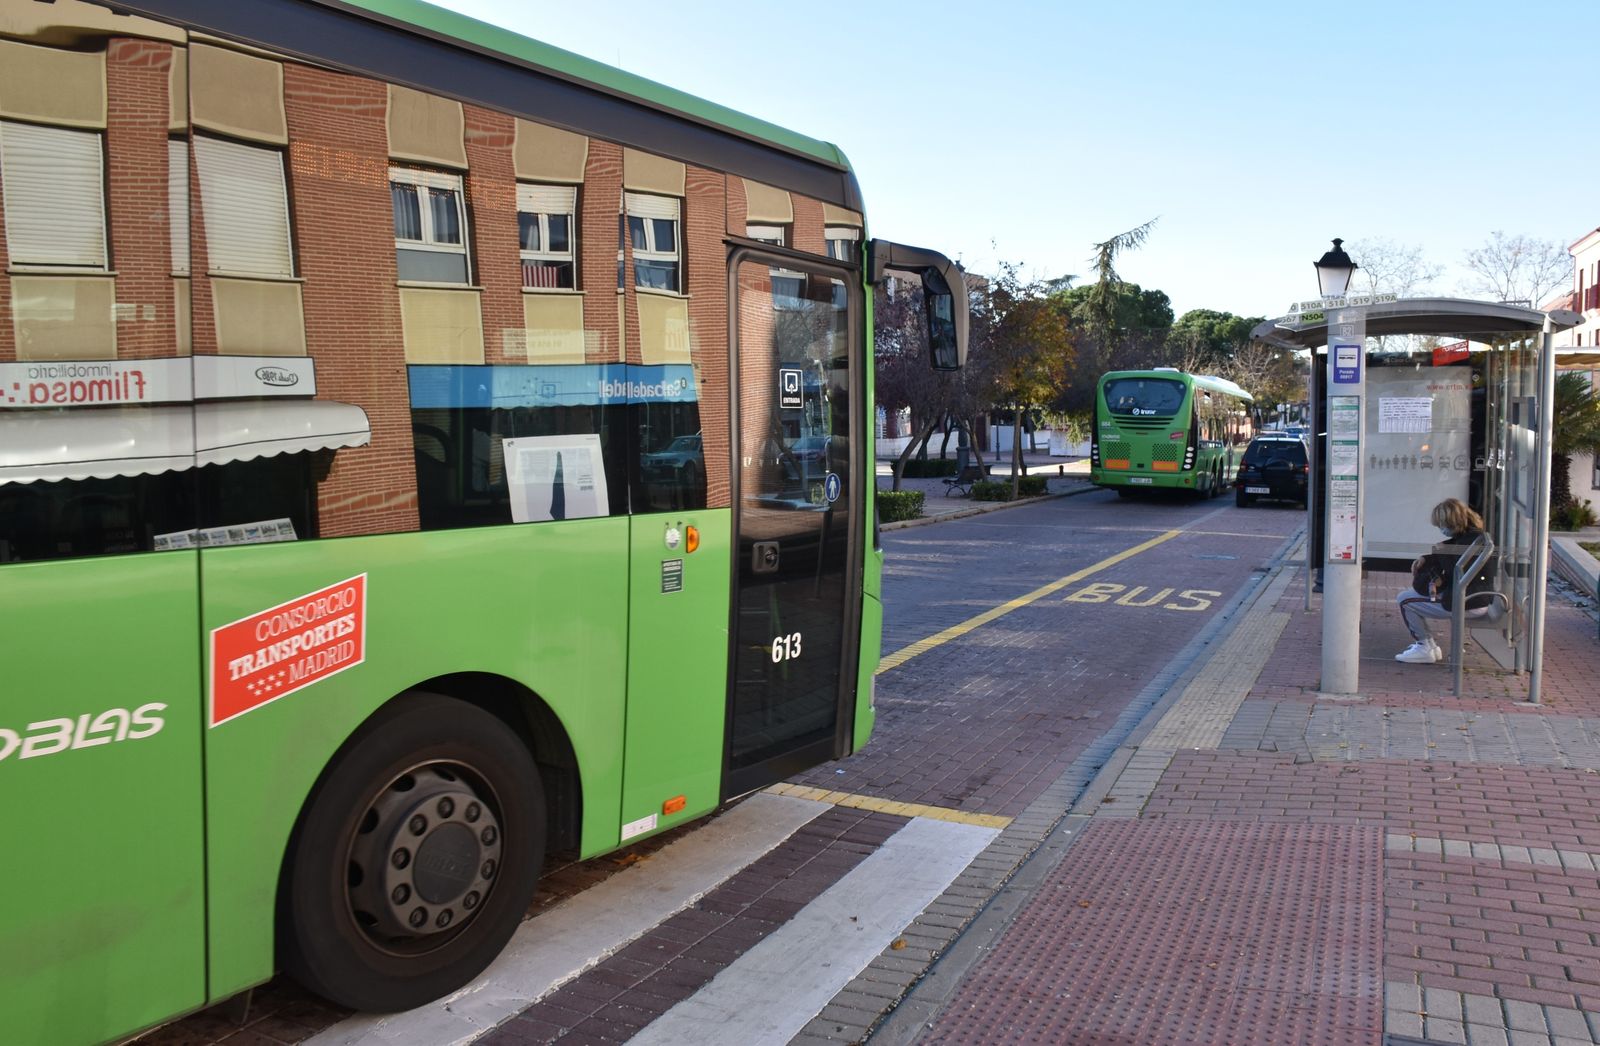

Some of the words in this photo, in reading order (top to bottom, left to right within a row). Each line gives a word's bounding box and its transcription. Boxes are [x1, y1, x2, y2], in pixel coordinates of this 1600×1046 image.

[1301, 302, 1323, 310] 510A
[1328, 300, 1346, 308] 518
[1353, 297, 1370, 305] 519
[1375, 295, 1397, 303] 519A
[1301, 313, 1324, 321] N504
[1063, 582, 1222, 611] BUS
[255, 586, 357, 643] CONSORCIO
[228, 612, 356, 682] TRANSPORTES
[287, 639, 355, 684] MADRID
[771, 632, 802, 663] 613
